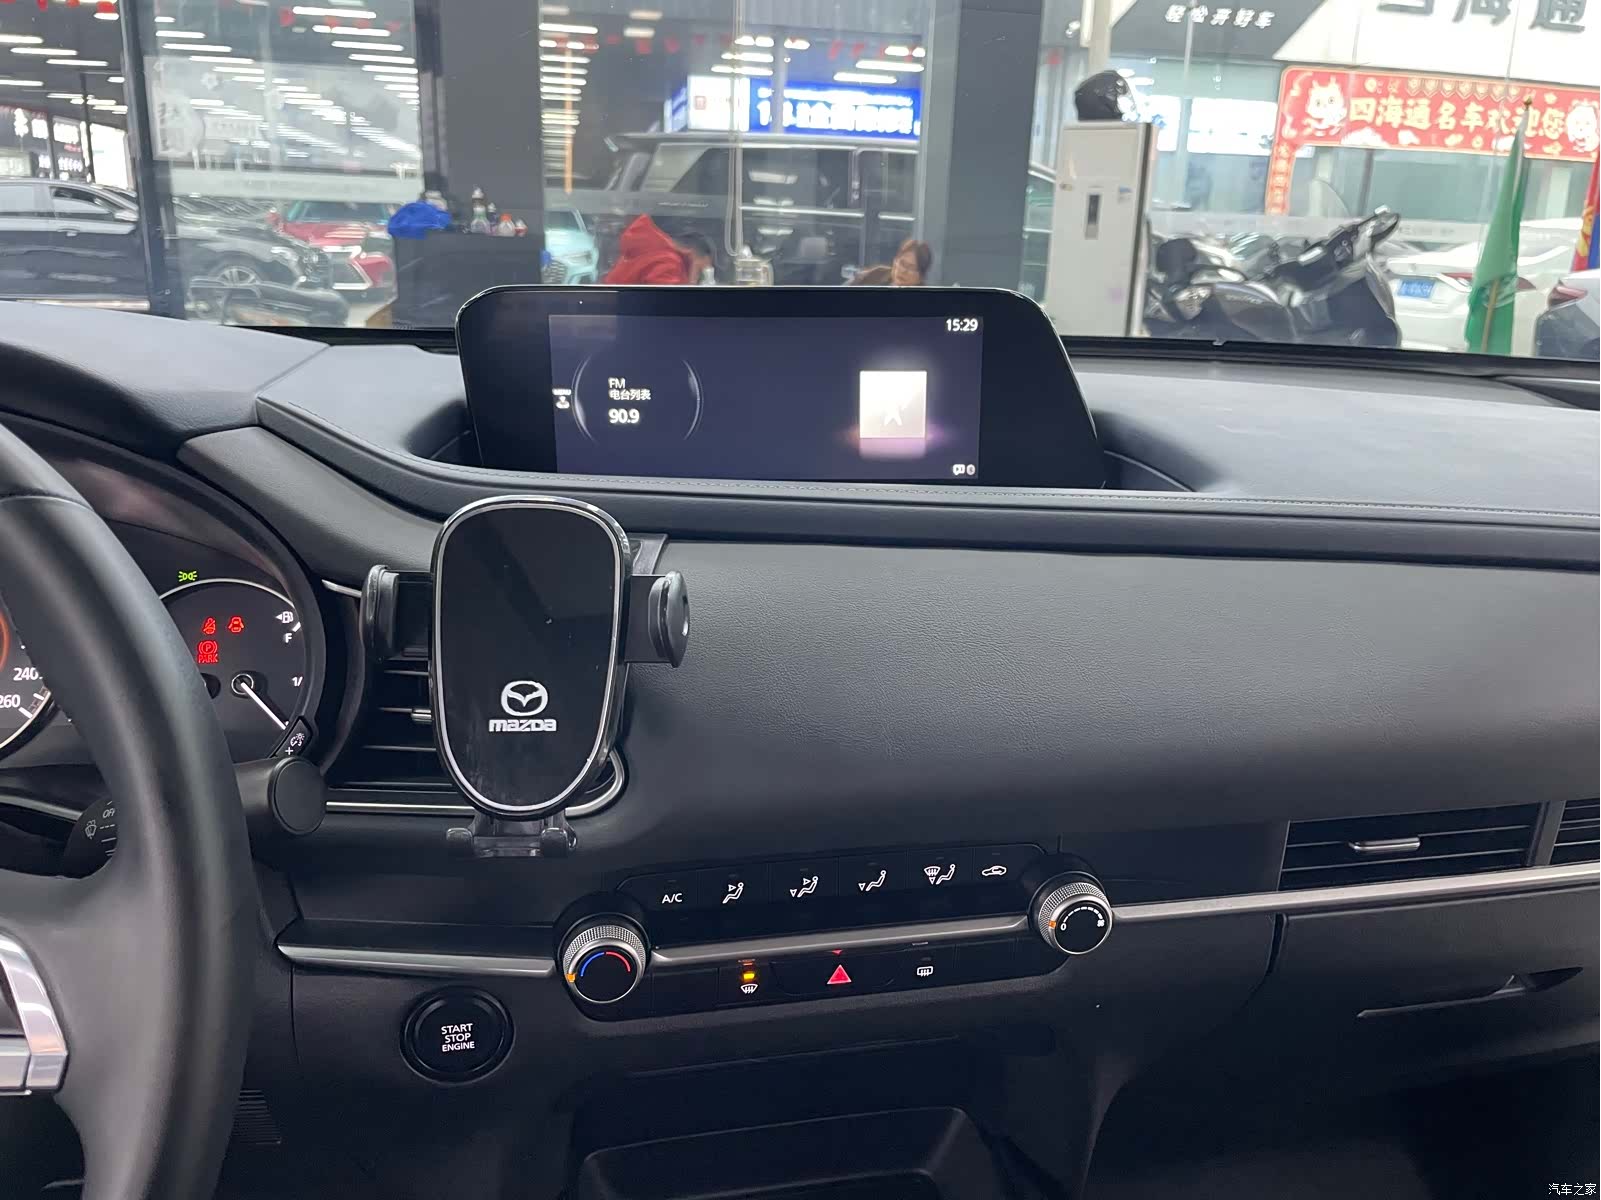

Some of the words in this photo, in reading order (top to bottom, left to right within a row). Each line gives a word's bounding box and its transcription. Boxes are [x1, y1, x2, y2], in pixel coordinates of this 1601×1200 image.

[1349, 96, 1566, 141] 四海通名车欢迎您
[945, 317, 979, 332] 15:29
[608, 377, 626, 389] FM
[608, 388, 652, 401] 电台列表
[608, 408, 640, 424] 90.9
[284, 633, 293, 643] F
[198, 653, 219, 664] PARK
[13, 666, 39, 681] 240
[661, 892, 683, 904] A/C
[440, 1022, 474, 1035] START
[444, 1032, 472, 1044] STOP
[441, 1040, 476, 1052] ENGINE
